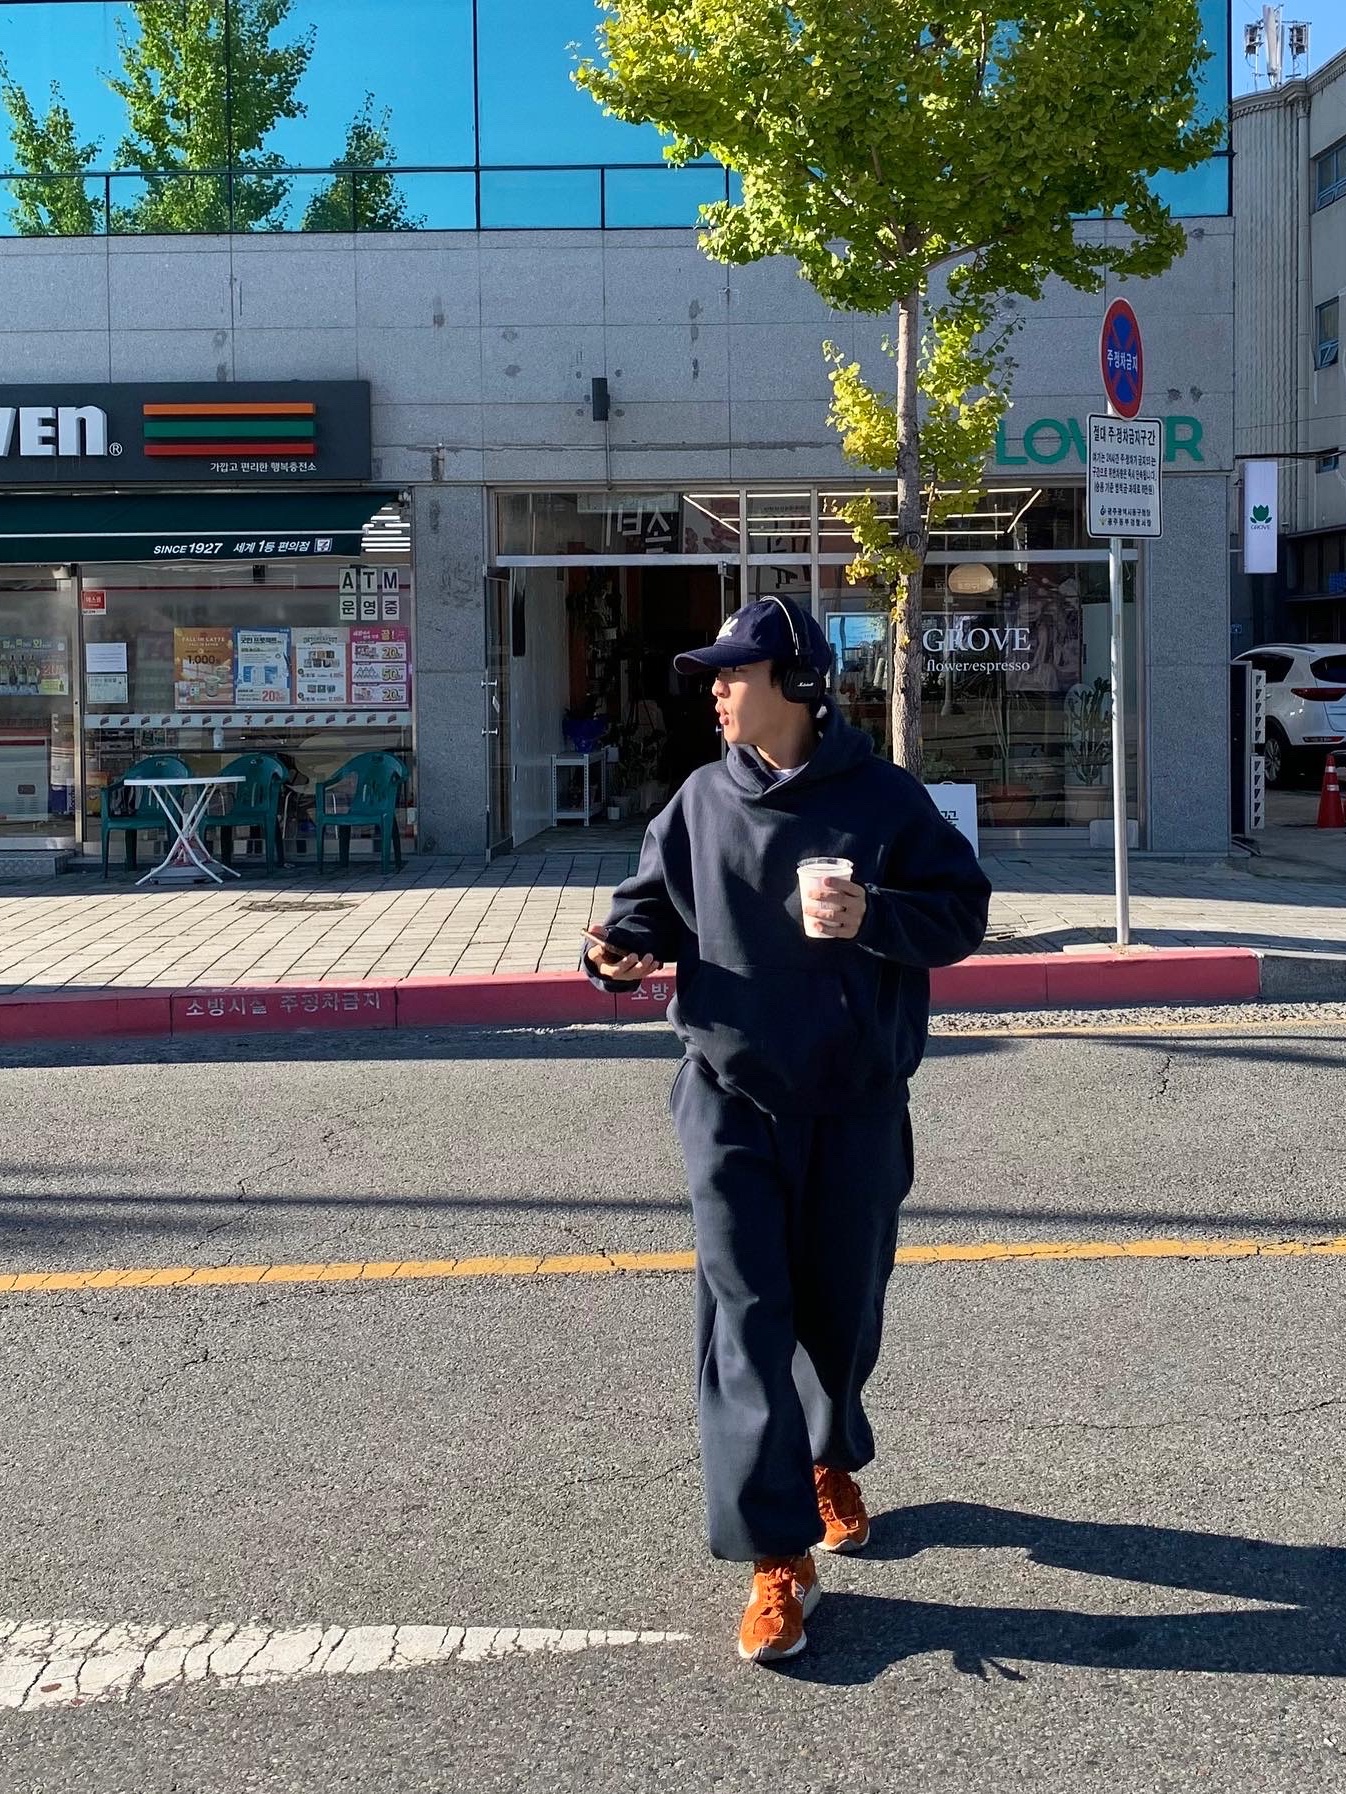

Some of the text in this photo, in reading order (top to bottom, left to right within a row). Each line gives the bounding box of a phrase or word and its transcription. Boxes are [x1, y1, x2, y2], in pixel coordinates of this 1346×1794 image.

[1107, 349, 1137, 372] 주정차금지
[1093, 425, 1106, 442] 절대
[210, 462, 317, 473] 가깝고 편리한 행복충전소
[153, 544, 189, 555] SINCE
[189, 543, 223, 555] 1927
[233, 541, 255, 553] 세계
[257, 540, 276, 553] 1등
[278, 541, 311, 553] 편의점
[342, 571, 397, 589] ATM
[341, 600, 398, 615] 운영중
[922, 628, 1031, 652] GROVE
[186, 996, 267, 1017] 소방시설
